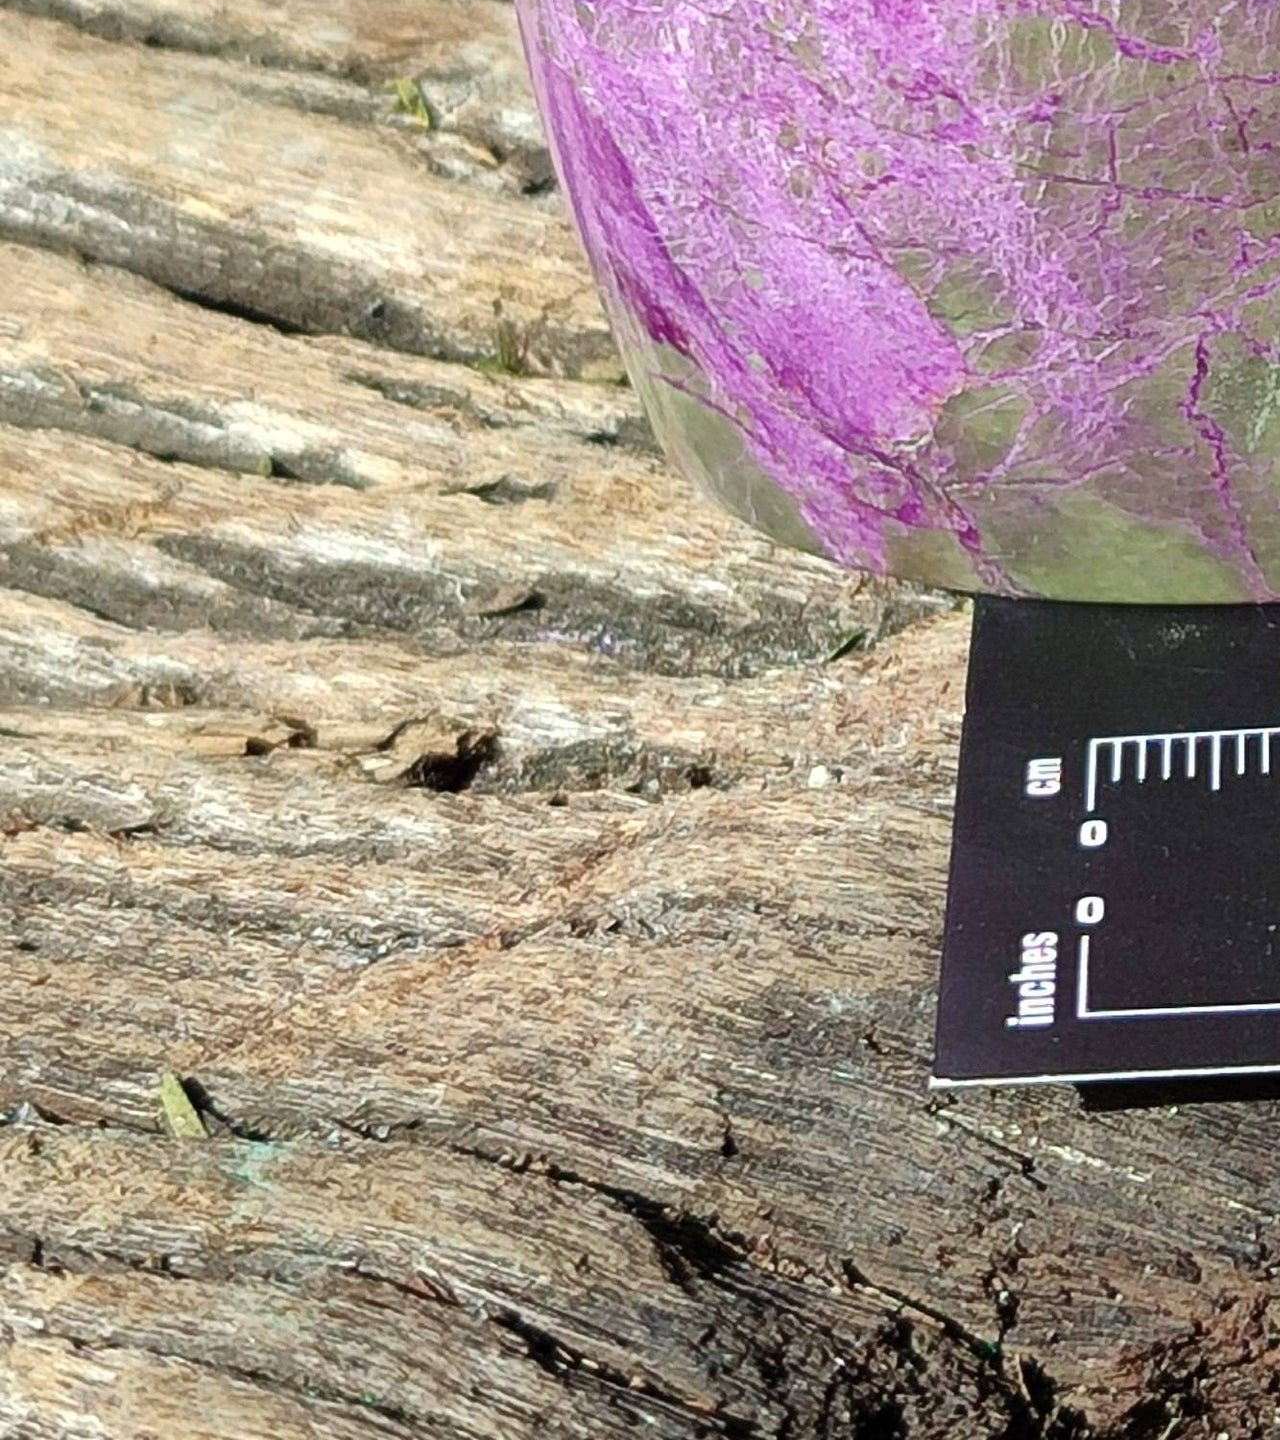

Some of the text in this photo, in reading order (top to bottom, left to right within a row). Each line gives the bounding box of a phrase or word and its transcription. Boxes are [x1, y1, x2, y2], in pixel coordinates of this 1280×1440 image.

[1025, 757, 1062, 797] cm
[1079, 819, 1108, 847] 0
[1075, 896, 1105, 925] 0
[1006, 931, 1059, 1027] inches
